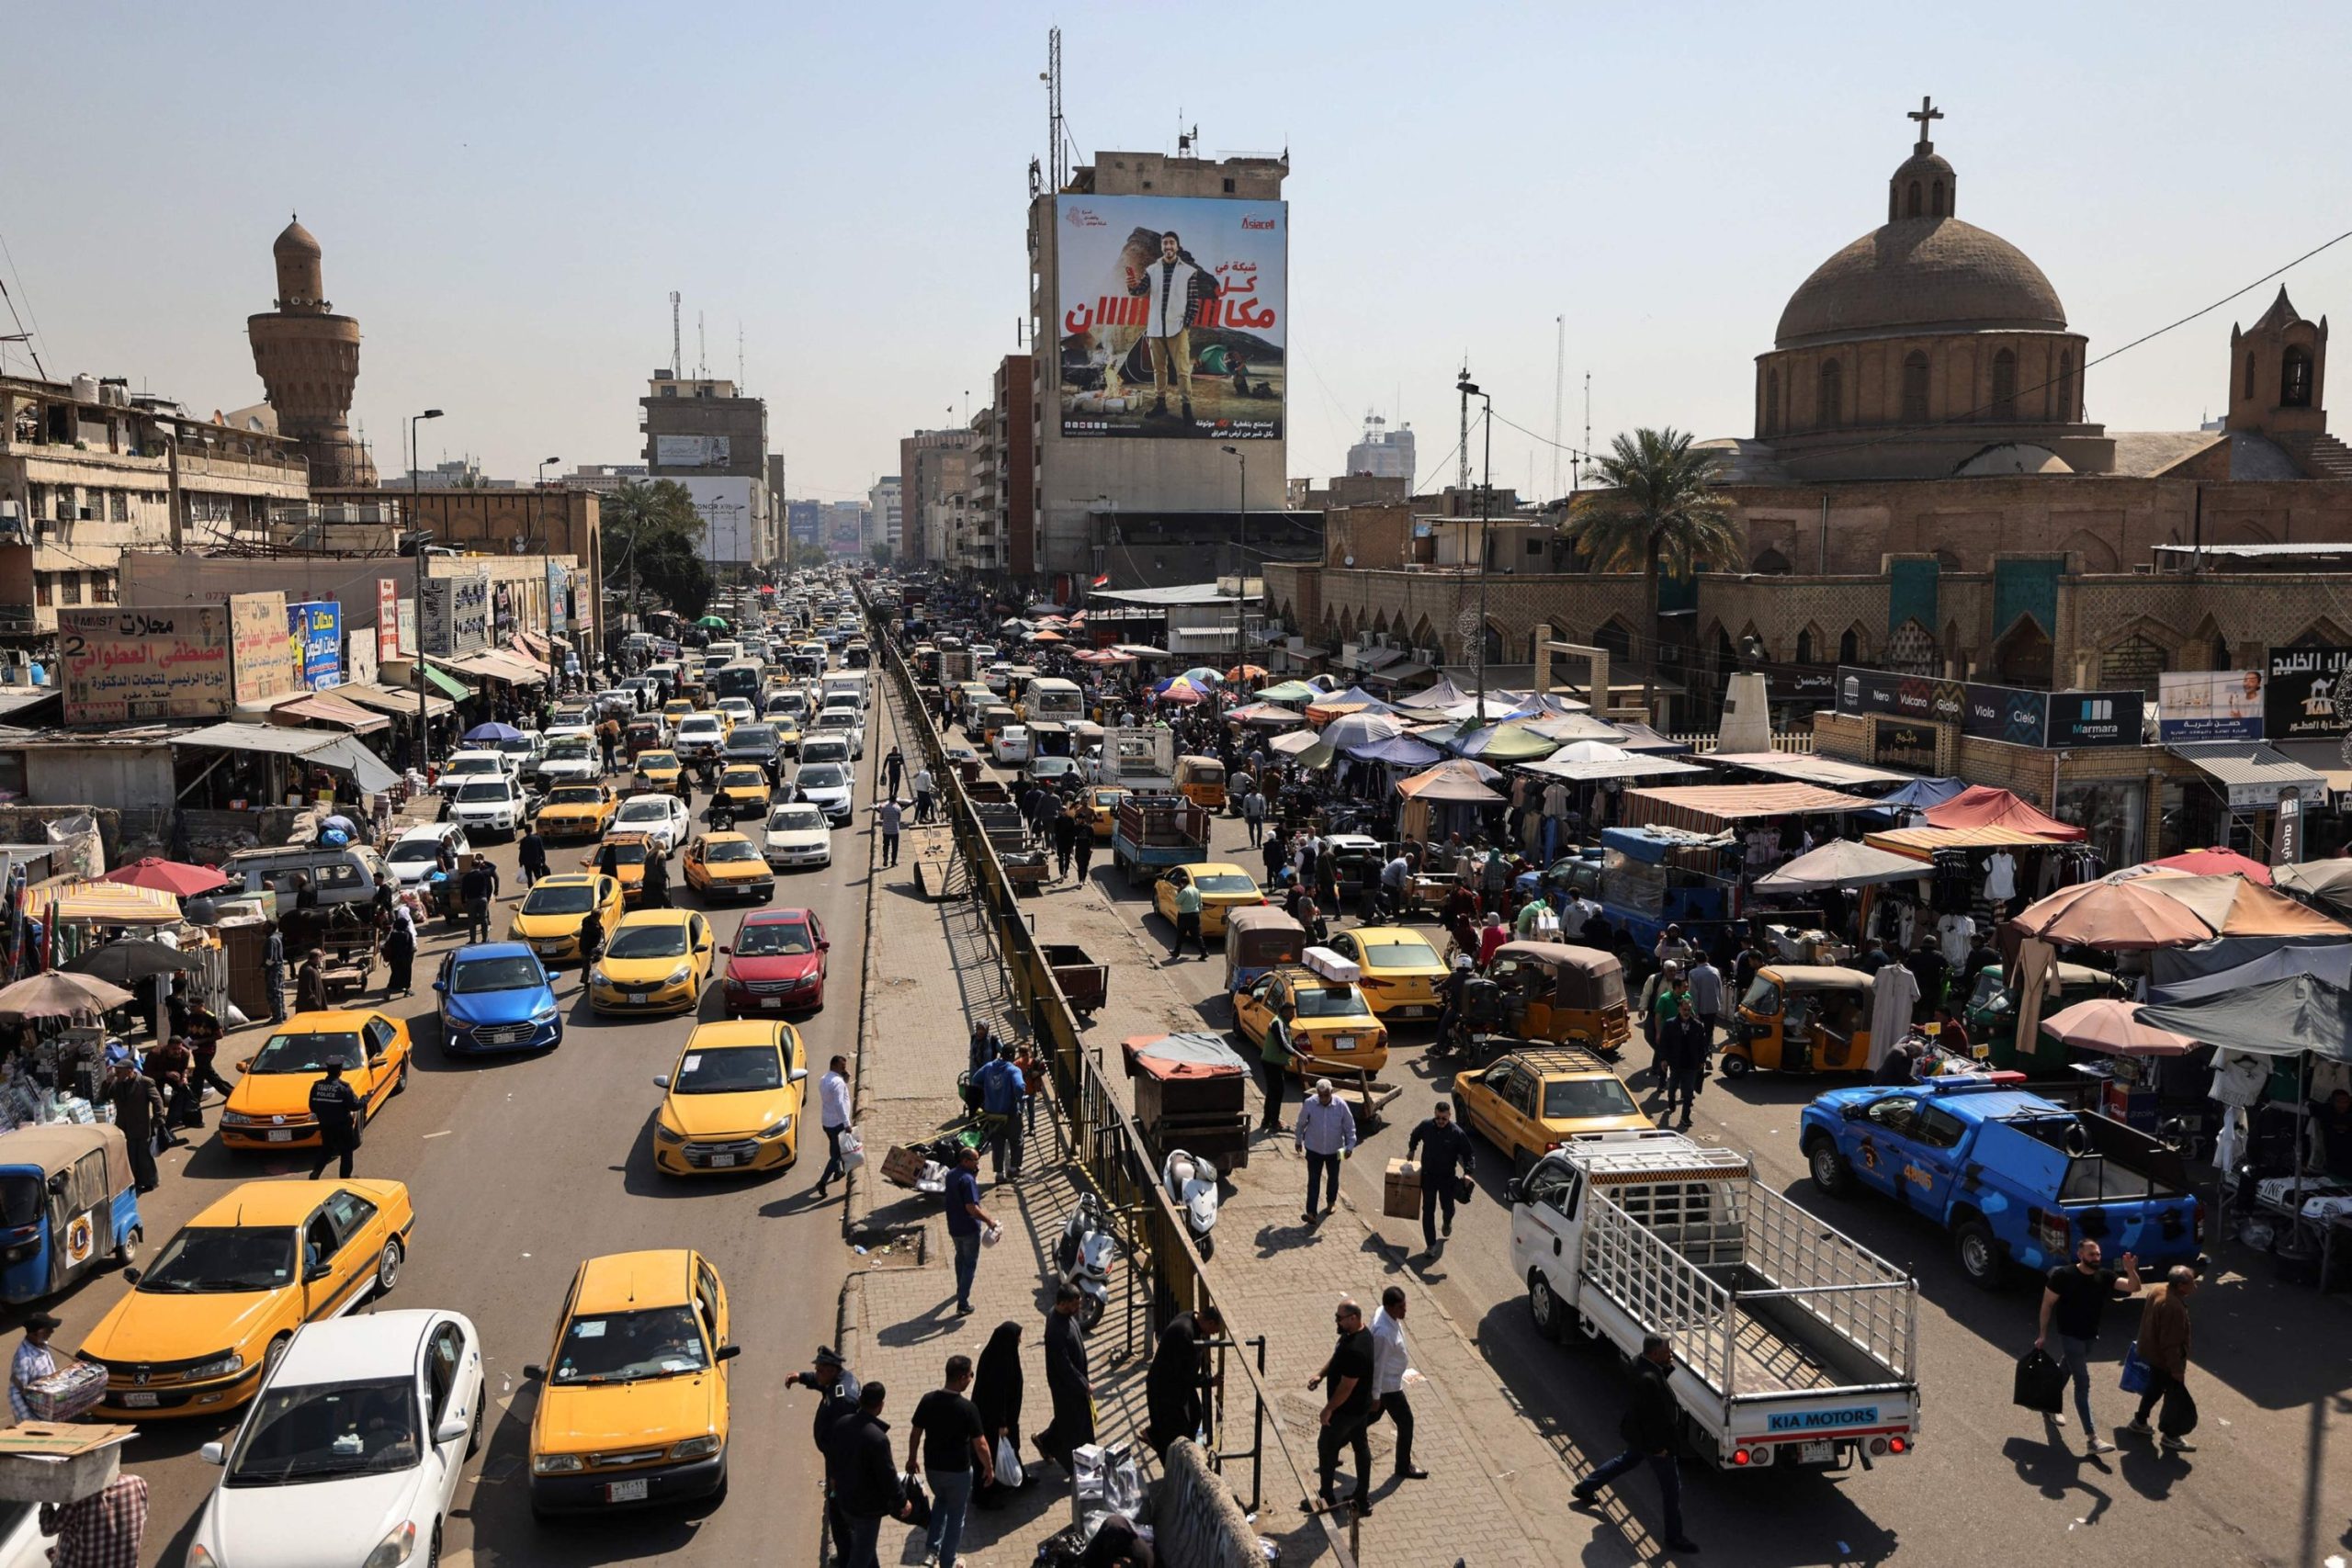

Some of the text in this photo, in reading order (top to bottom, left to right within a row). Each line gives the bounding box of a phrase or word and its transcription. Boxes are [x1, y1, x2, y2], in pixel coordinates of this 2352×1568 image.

[1242, 217, 1274, 229] Asiacell
[1215, 261, 1257, 275] شبكة في
[1215, 276, 1257, 298] كل
[80, 615, 115, 627] MMST
[119, 614, 174, 637] محلات
[312, 610, 334, 631] محلات
[234, 621, 242, 640] 2
[65, 636, 86, 657] 2
[70, 642, 153, 677] العطواني
[2273, 652, 2322, 676] الخليج
[167, 671, 203, 690] الرئيسي
[1794, 673, 1833, 690] محسن
[1873, 690, 1890, 702] Nero
[1900, 694, 1928, 707] Vulcano
[1937, 699, 1959, 713] Giallo
[1974, 705, 1995, 718] Viola
[2013, 710, 2035, 725] Cielo
[2214, 719, 2241, 728] حسن
[2073, 724, 2118, 734] Marmara
[2289, 720, 2320, 732] العطور
[318, 1084, 338, 1092] TRAFFIC
[1866, 1153, 1874, 1168] 3
[76, 1229, 85, 1248] L
[1771, 1408, 1875, 1429] KIA MOTORS
